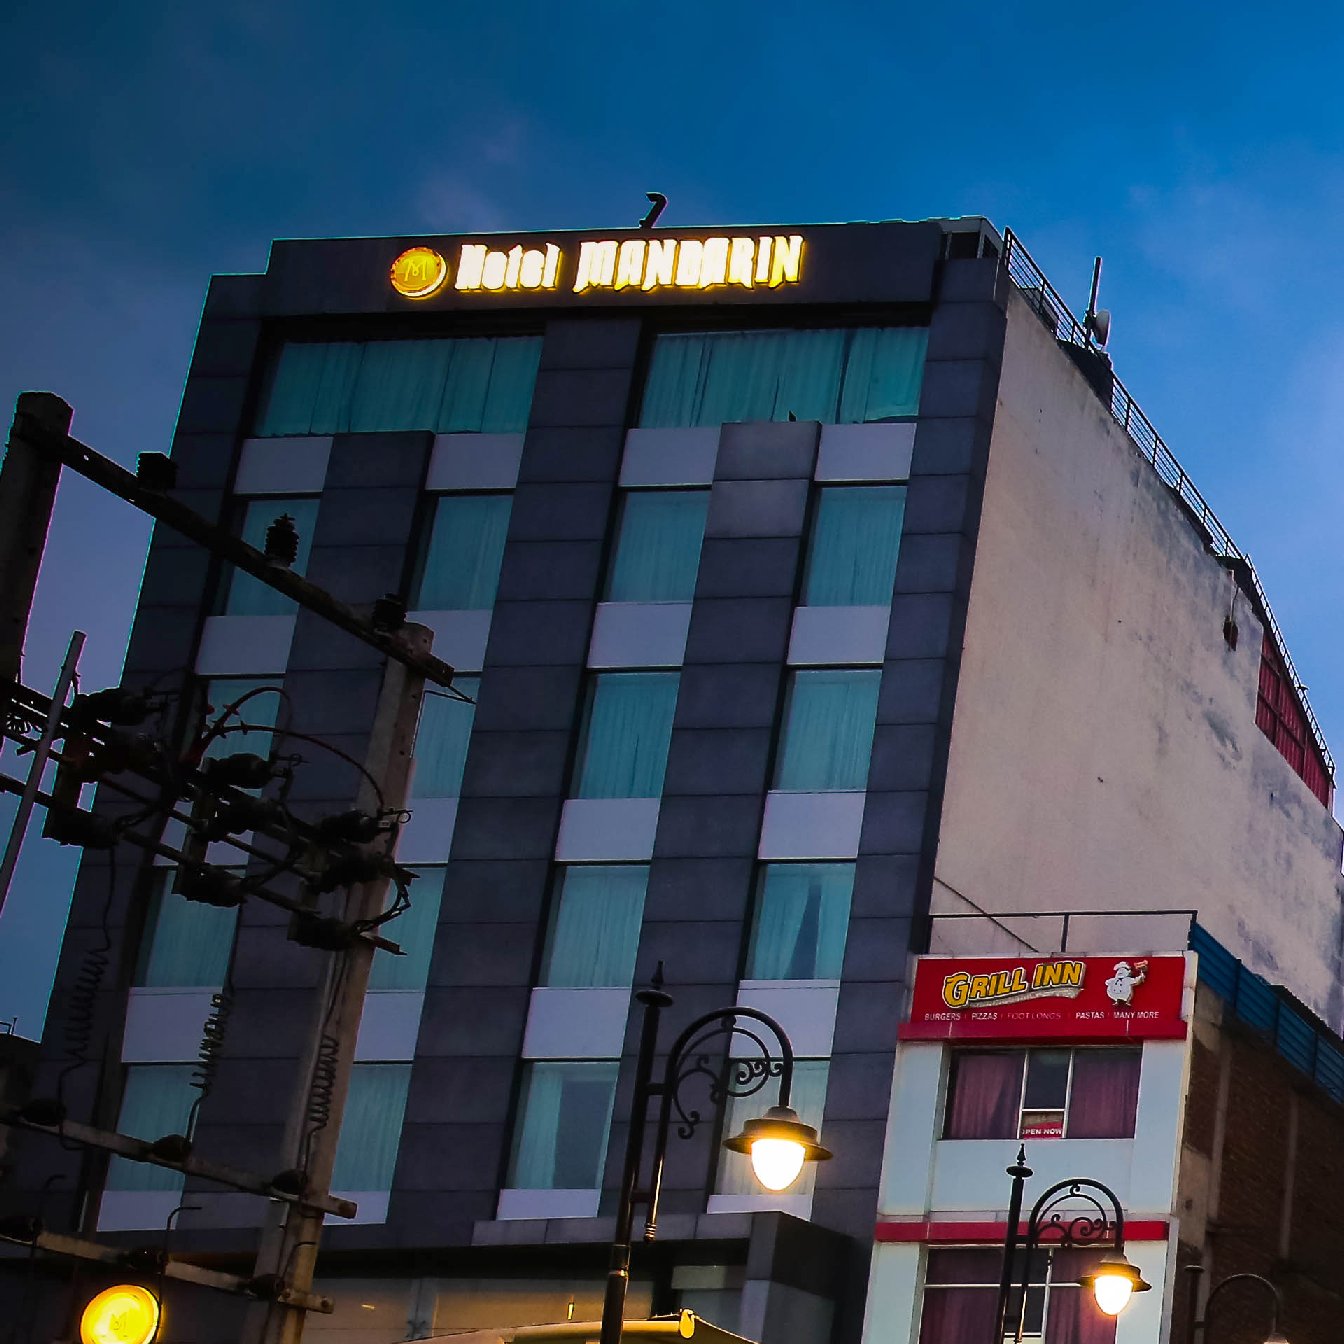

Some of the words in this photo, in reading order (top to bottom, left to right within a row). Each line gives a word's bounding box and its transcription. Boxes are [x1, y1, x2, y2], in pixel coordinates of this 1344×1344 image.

[455, 243, 562, 291] Hotel
[942, 967, 1028, 1009] GRILL
[1033, 961, 1086, 988] INN
[924, 1012, 961, 1021] BURGERS
[971, 1012, 998, 1021] PIZZAS
[1075, 1011, 1105, 1020] PASTAS
[1113, 1011, 1135, 1020] MANY
[1136, 1011, 1160, 1019] MORE
